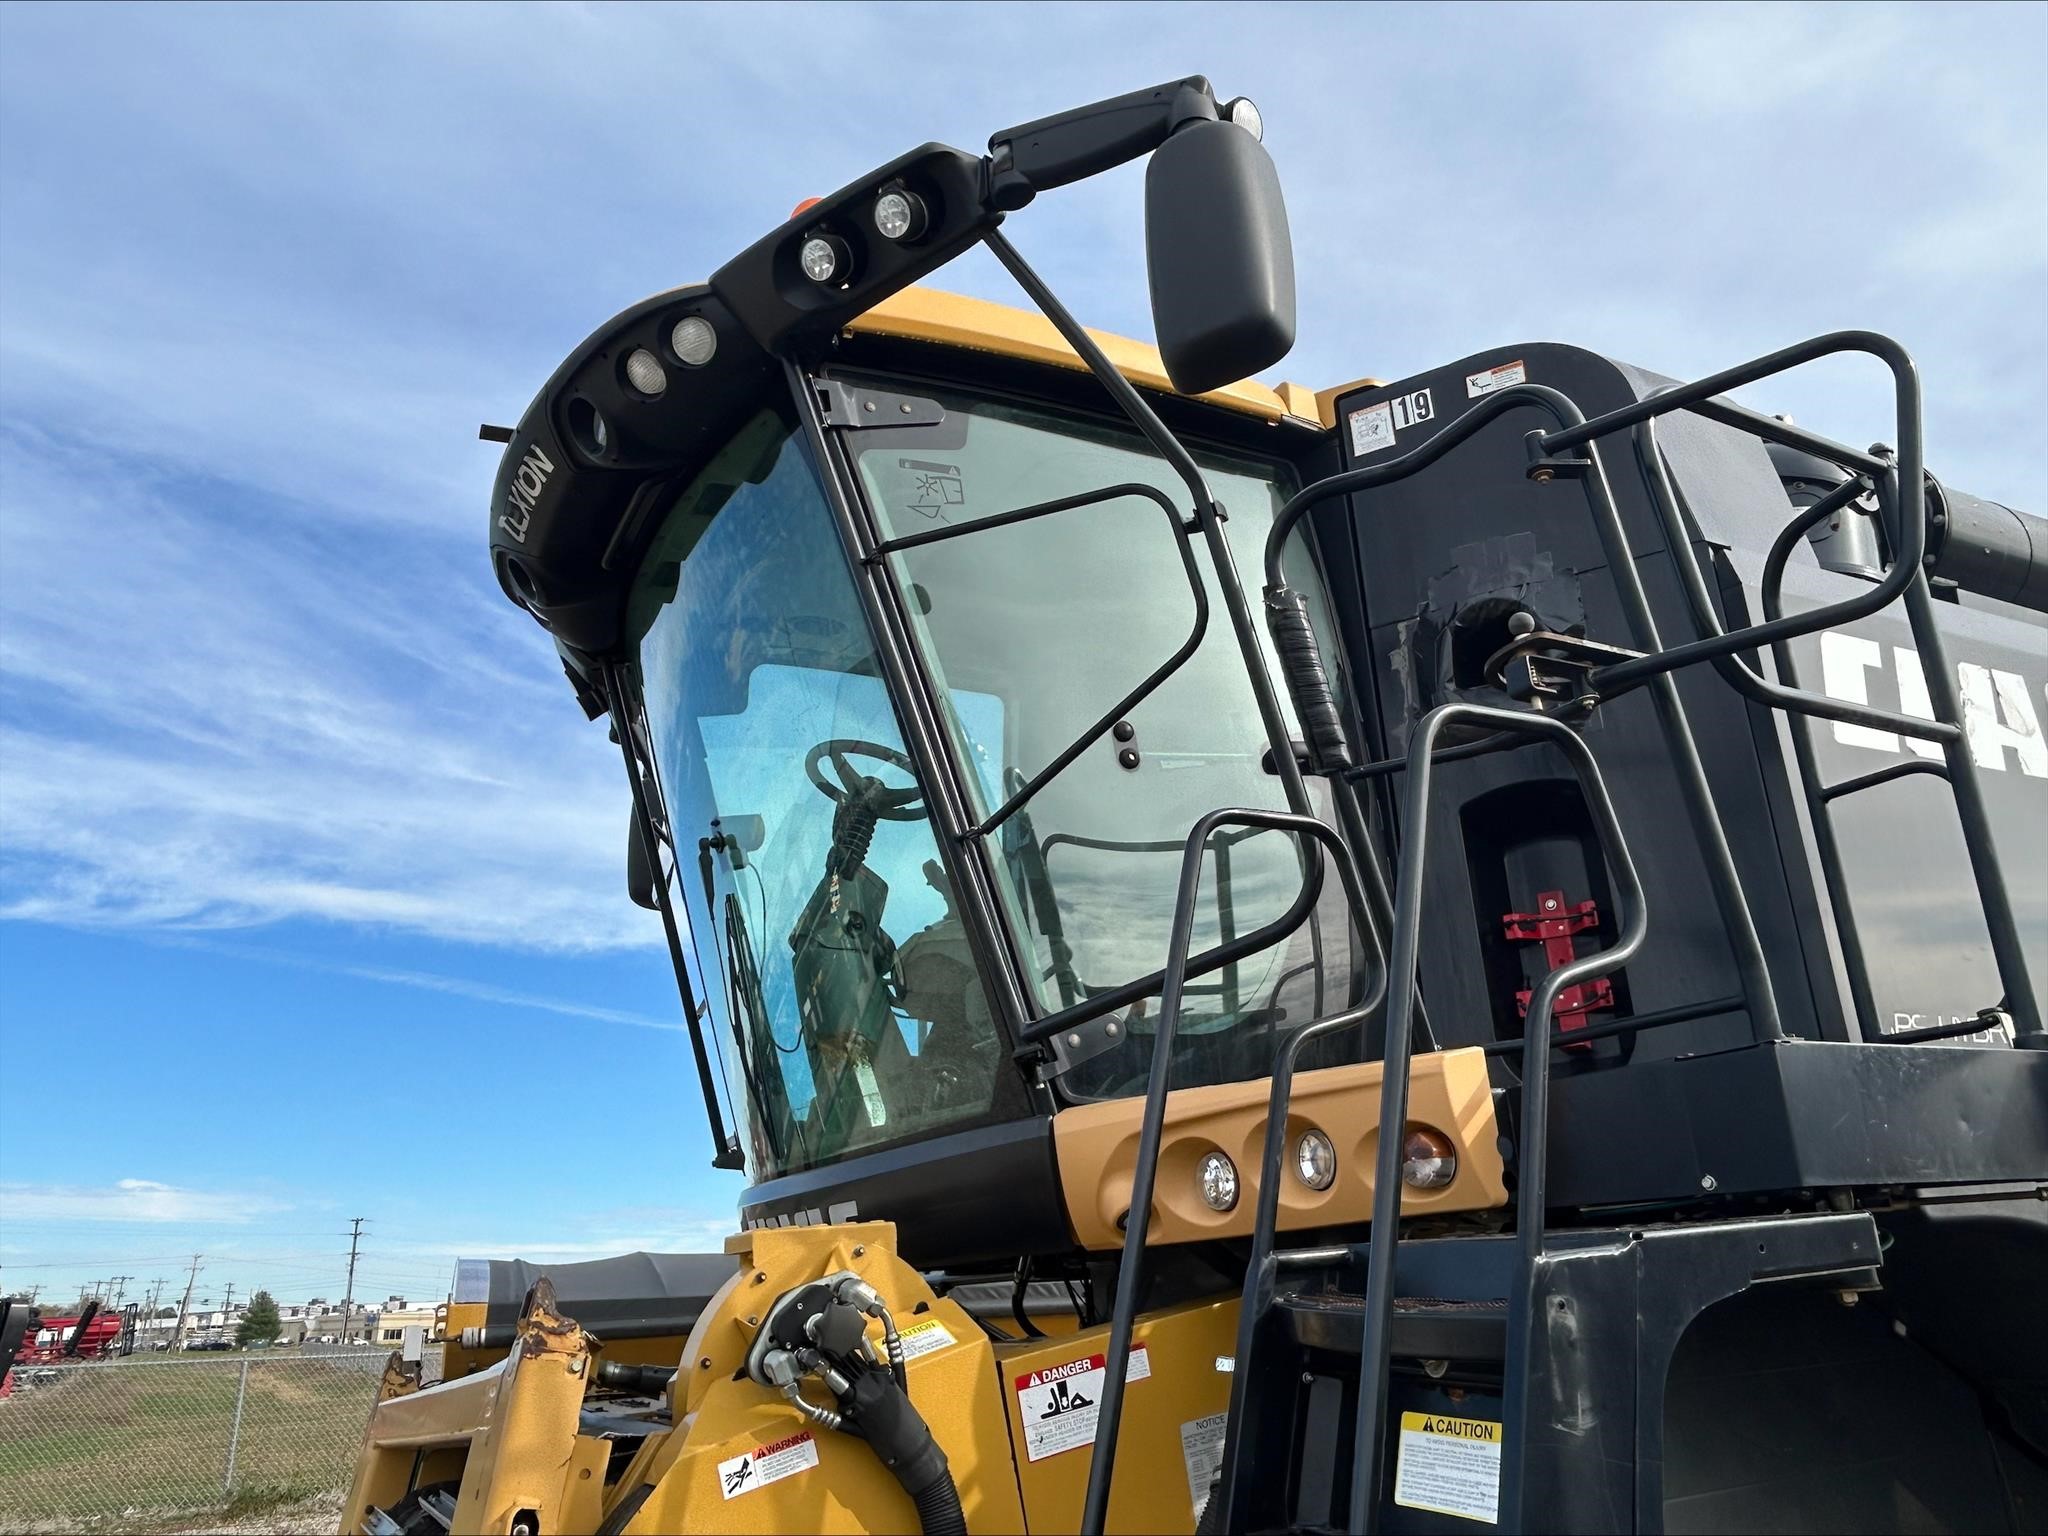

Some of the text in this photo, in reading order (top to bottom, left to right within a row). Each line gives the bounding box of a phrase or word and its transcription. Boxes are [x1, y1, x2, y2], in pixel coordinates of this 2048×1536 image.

[1398, 392, 1431, 425] 19
[1820, 631, 2048, 779] CLA
[896, 1322, 936, 1339] AUTION
[1042, 1359, 1092, 1382] DANGER
[1195, 1414, 1225, 1430] NOTICE
[1436, 1419, 1493, 1439] CAUTION
[765, 1431, 810, 1455] WARNING
